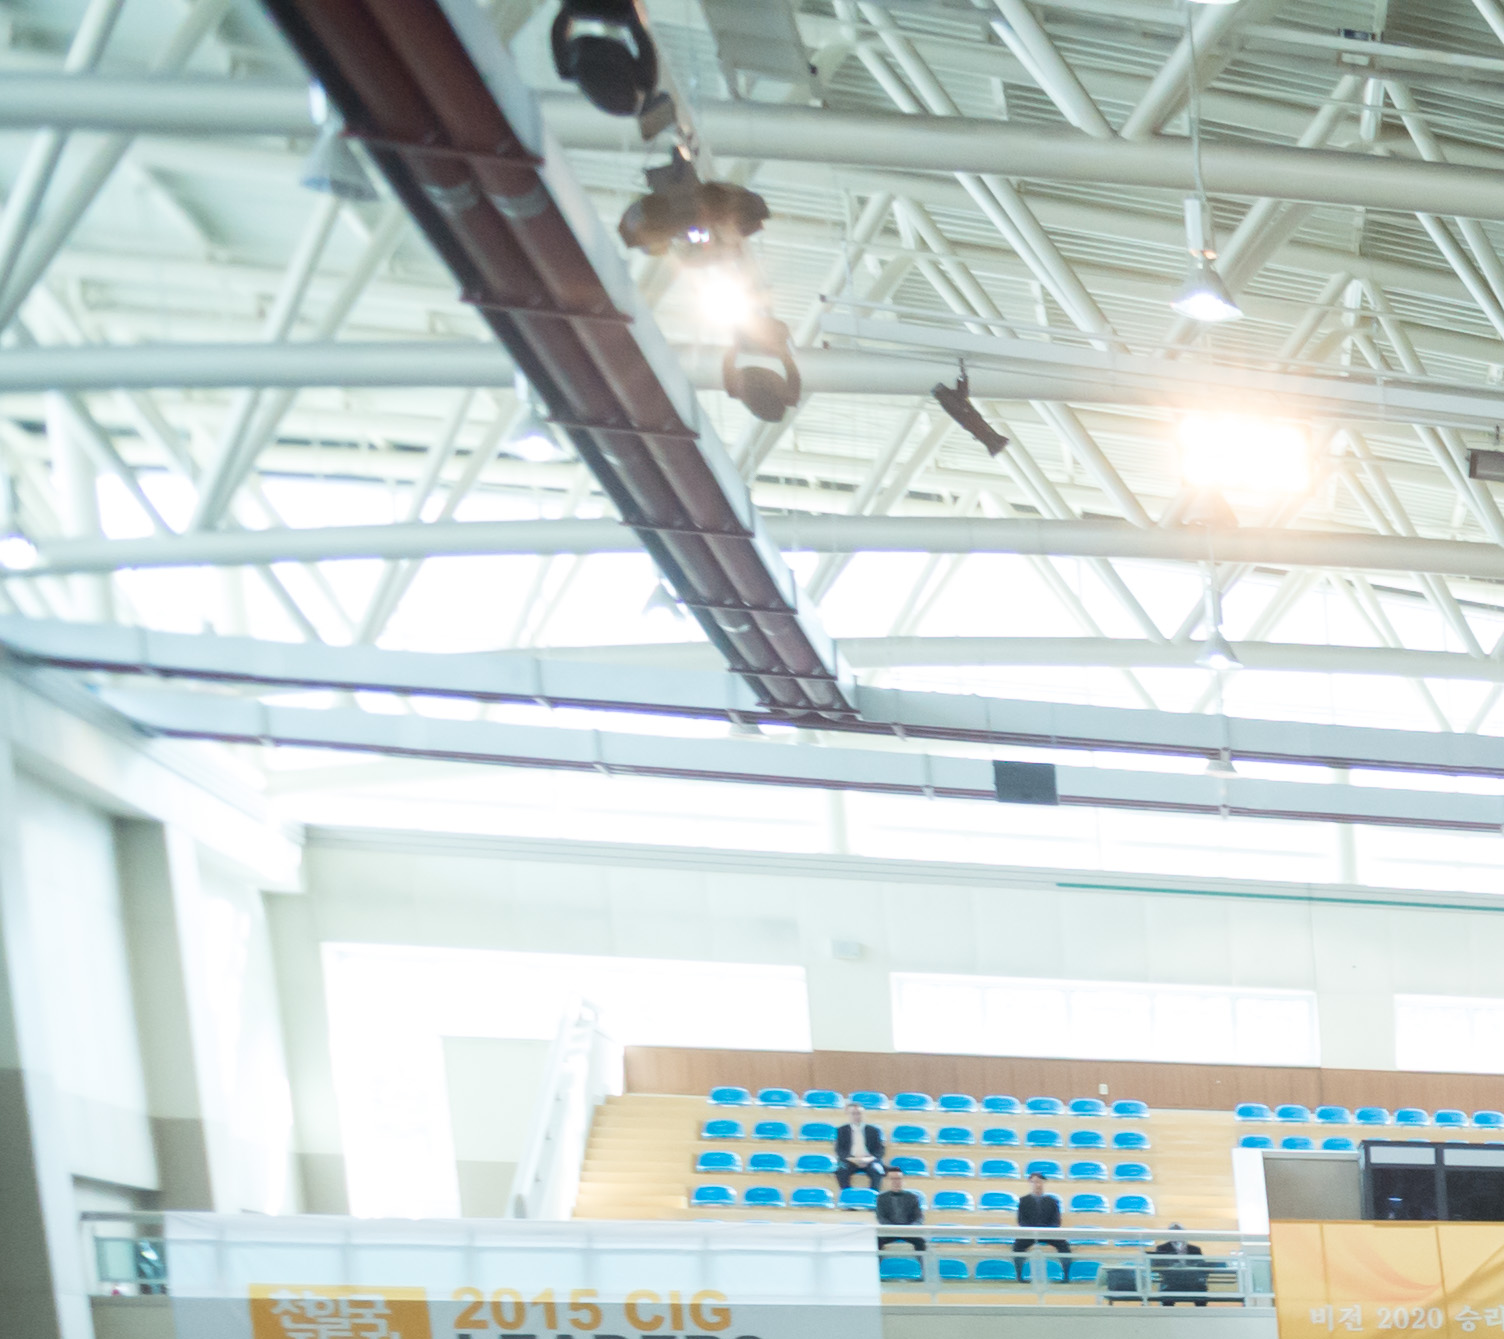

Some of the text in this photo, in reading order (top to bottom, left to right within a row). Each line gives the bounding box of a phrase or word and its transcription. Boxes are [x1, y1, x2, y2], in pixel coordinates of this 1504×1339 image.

[452, 1286, 733, 1331] 2015 CIG
[1309, 1304, 1364, 1332] 비전
[1377, 1306, 1444, 1331] 2020
